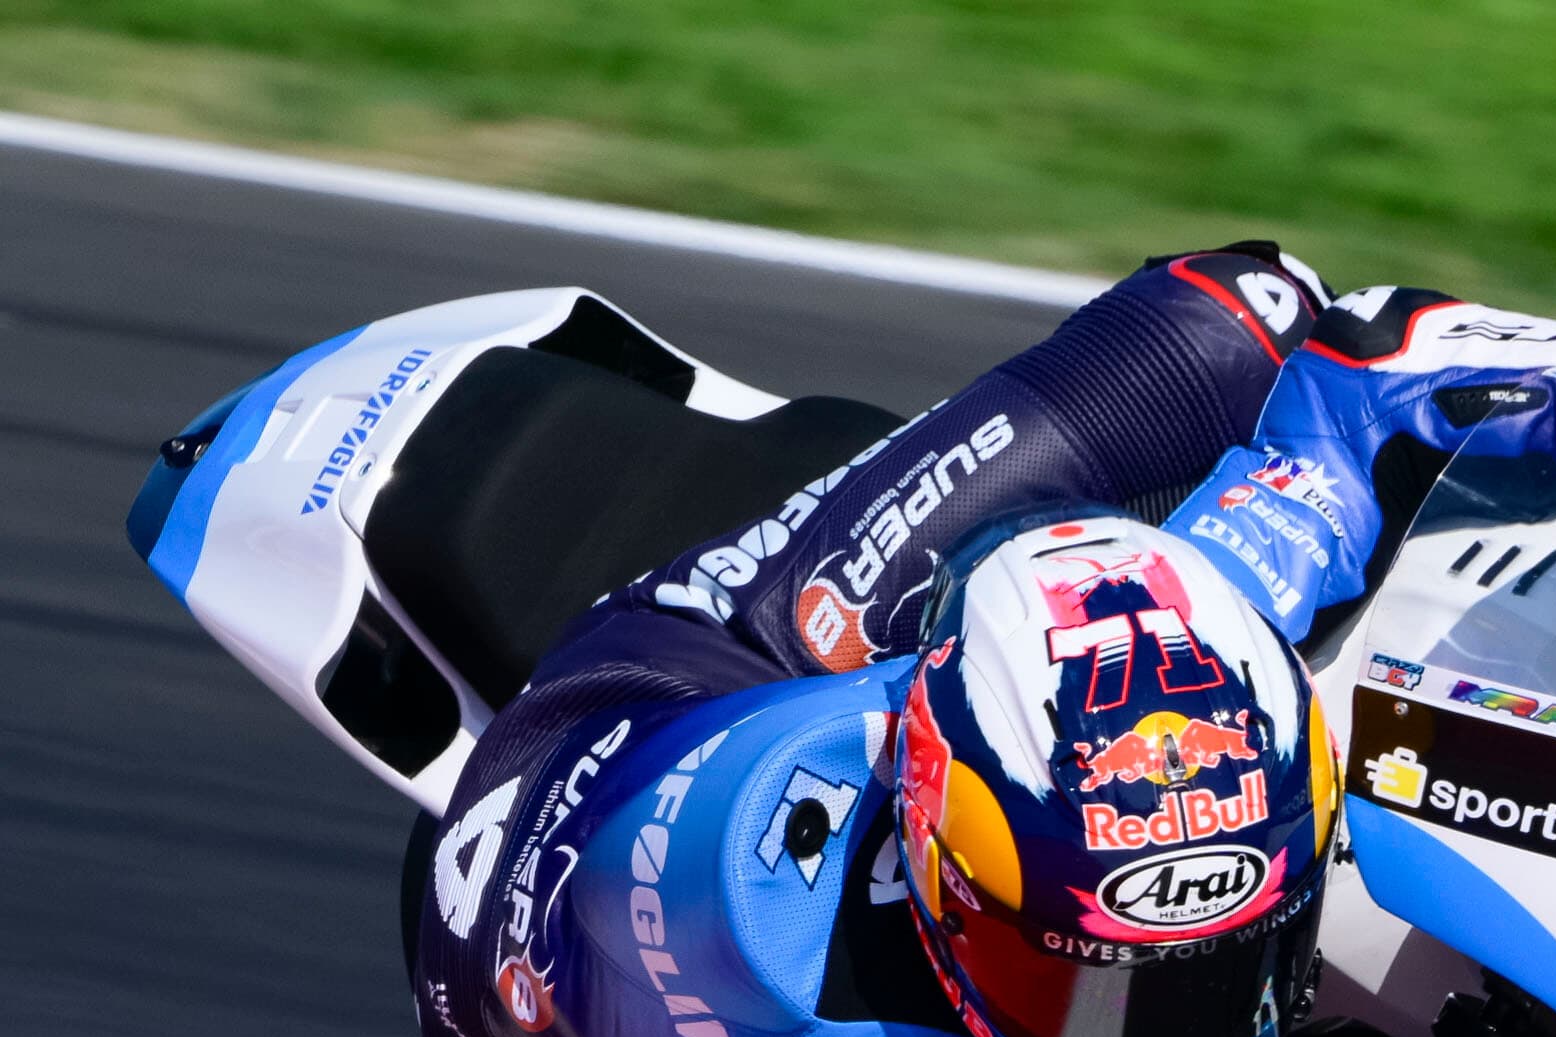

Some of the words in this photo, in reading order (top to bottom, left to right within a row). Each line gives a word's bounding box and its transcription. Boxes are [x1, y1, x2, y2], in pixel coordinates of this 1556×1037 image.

[843, 413, 1014, 597] SUPER
[1045, 605, 1225, 713] 71
[533, 780, 565, 832] lithium
[1081, 791, 1185, 850] Red
[1181, 768, 1269, 842] Bull
[1112, 853, 1248, 912] Arai
[1043, 932, 1133, 961] GIVES
[1156, 940, 1217, 962] YOU
